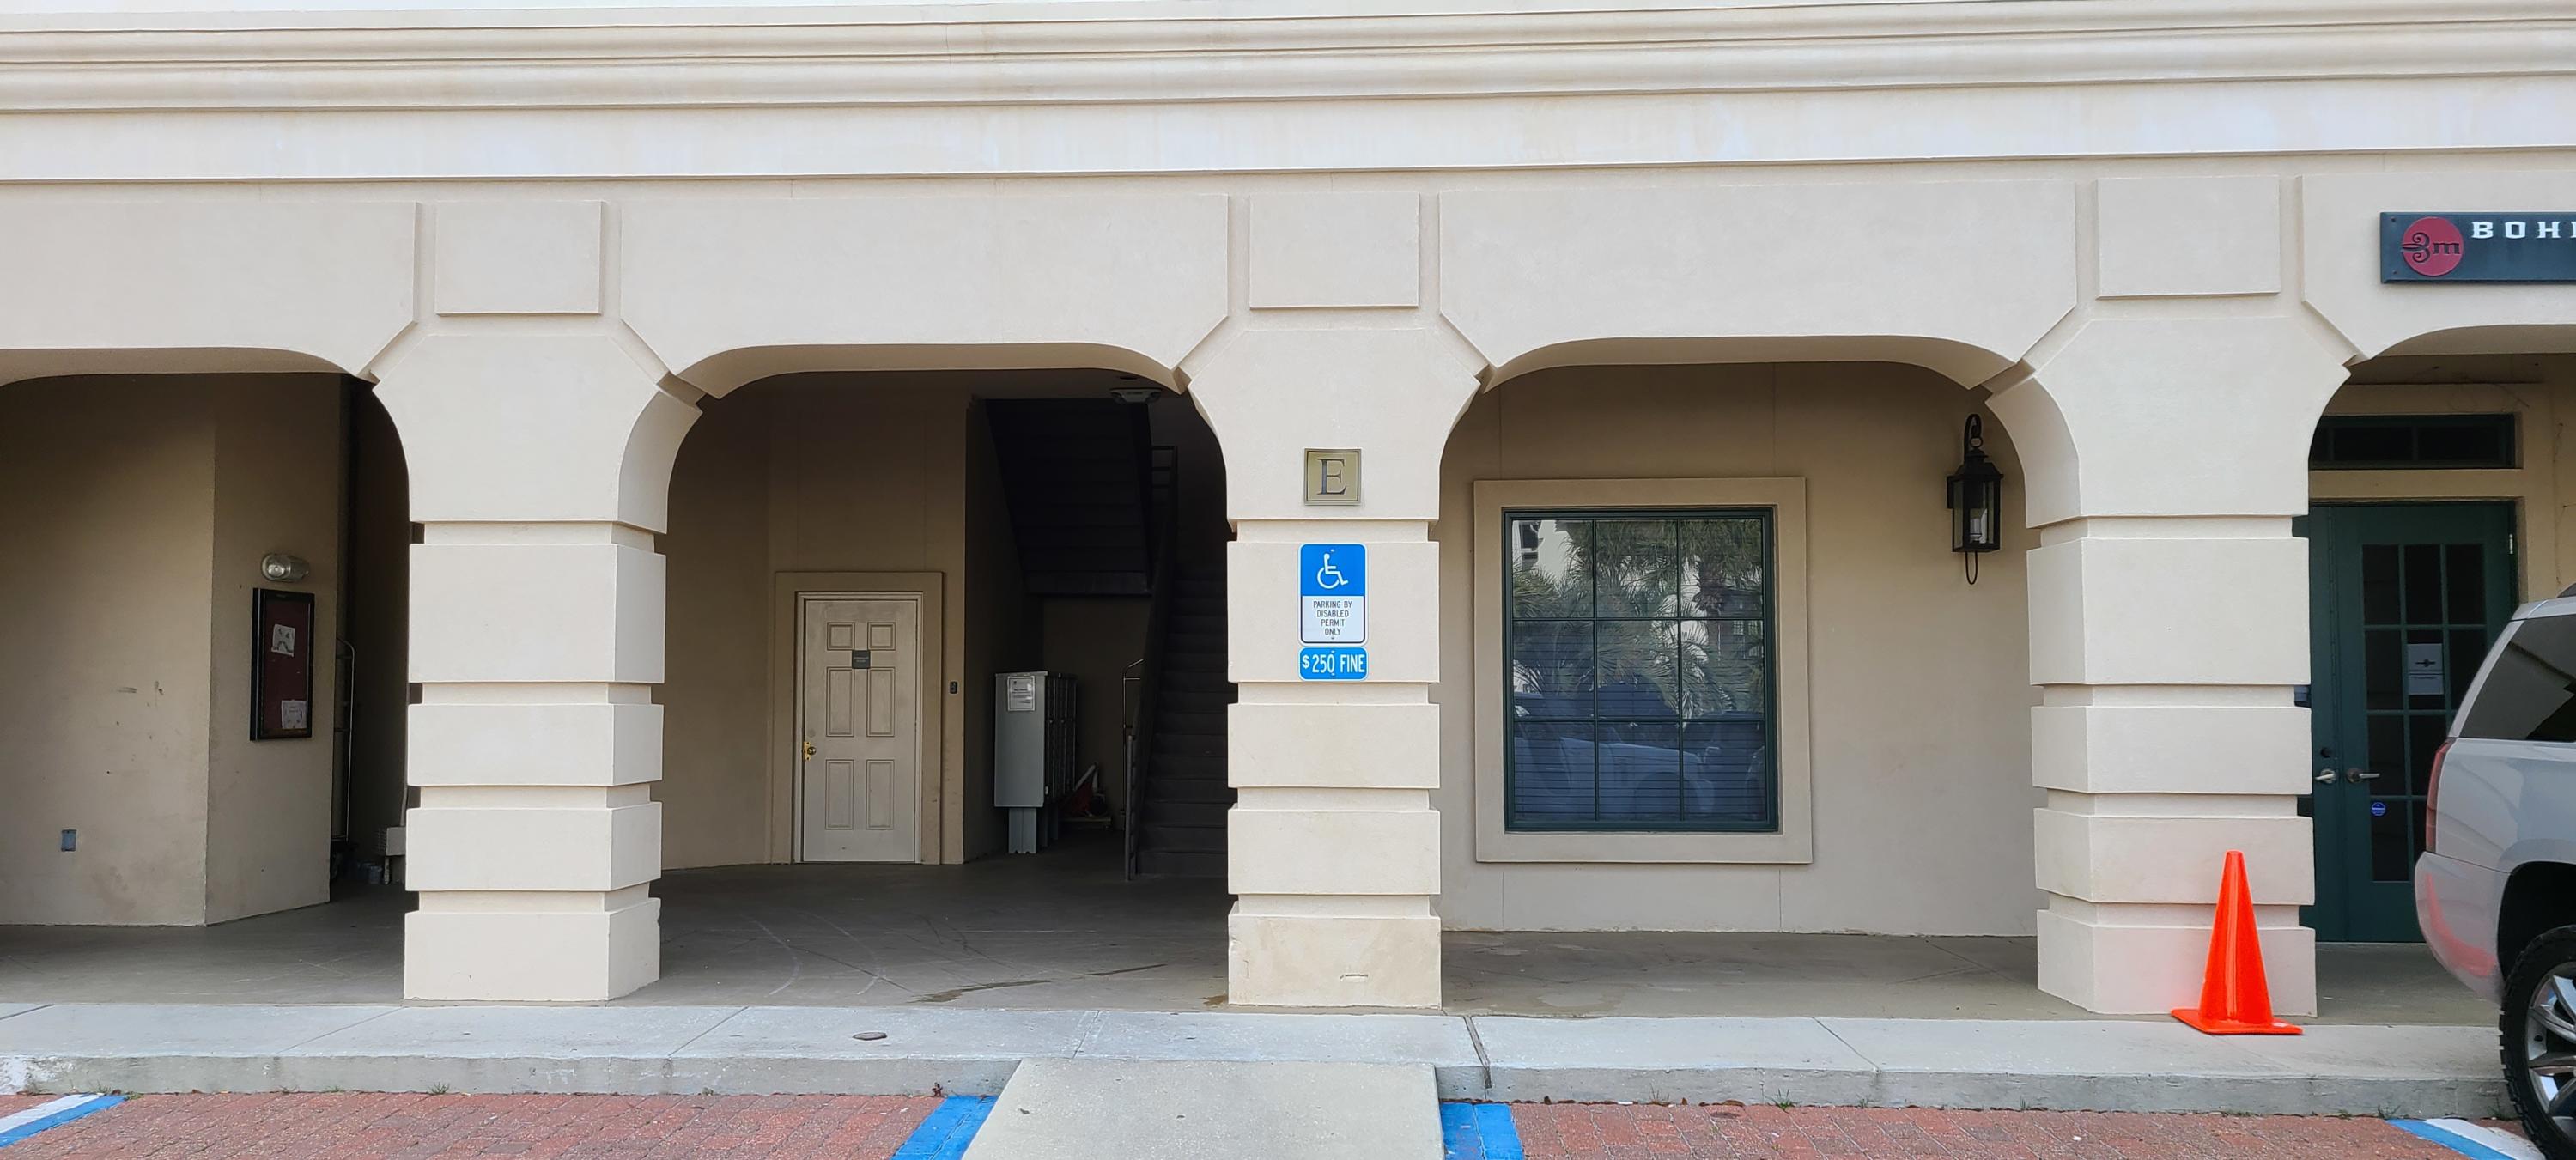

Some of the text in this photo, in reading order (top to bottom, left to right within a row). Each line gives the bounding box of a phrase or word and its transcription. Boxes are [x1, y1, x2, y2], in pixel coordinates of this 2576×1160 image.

[1316, 458, 1347, 495] E
[1313, 600, 1352, 609] PARKING BY
[1316, 610, 1350, 618] DISABLED
[1321, 618, 1346, 627] PERMIT
[1324, 628, 1341, 636] ONLY
[1340, 653, 1365, 673] FINE
